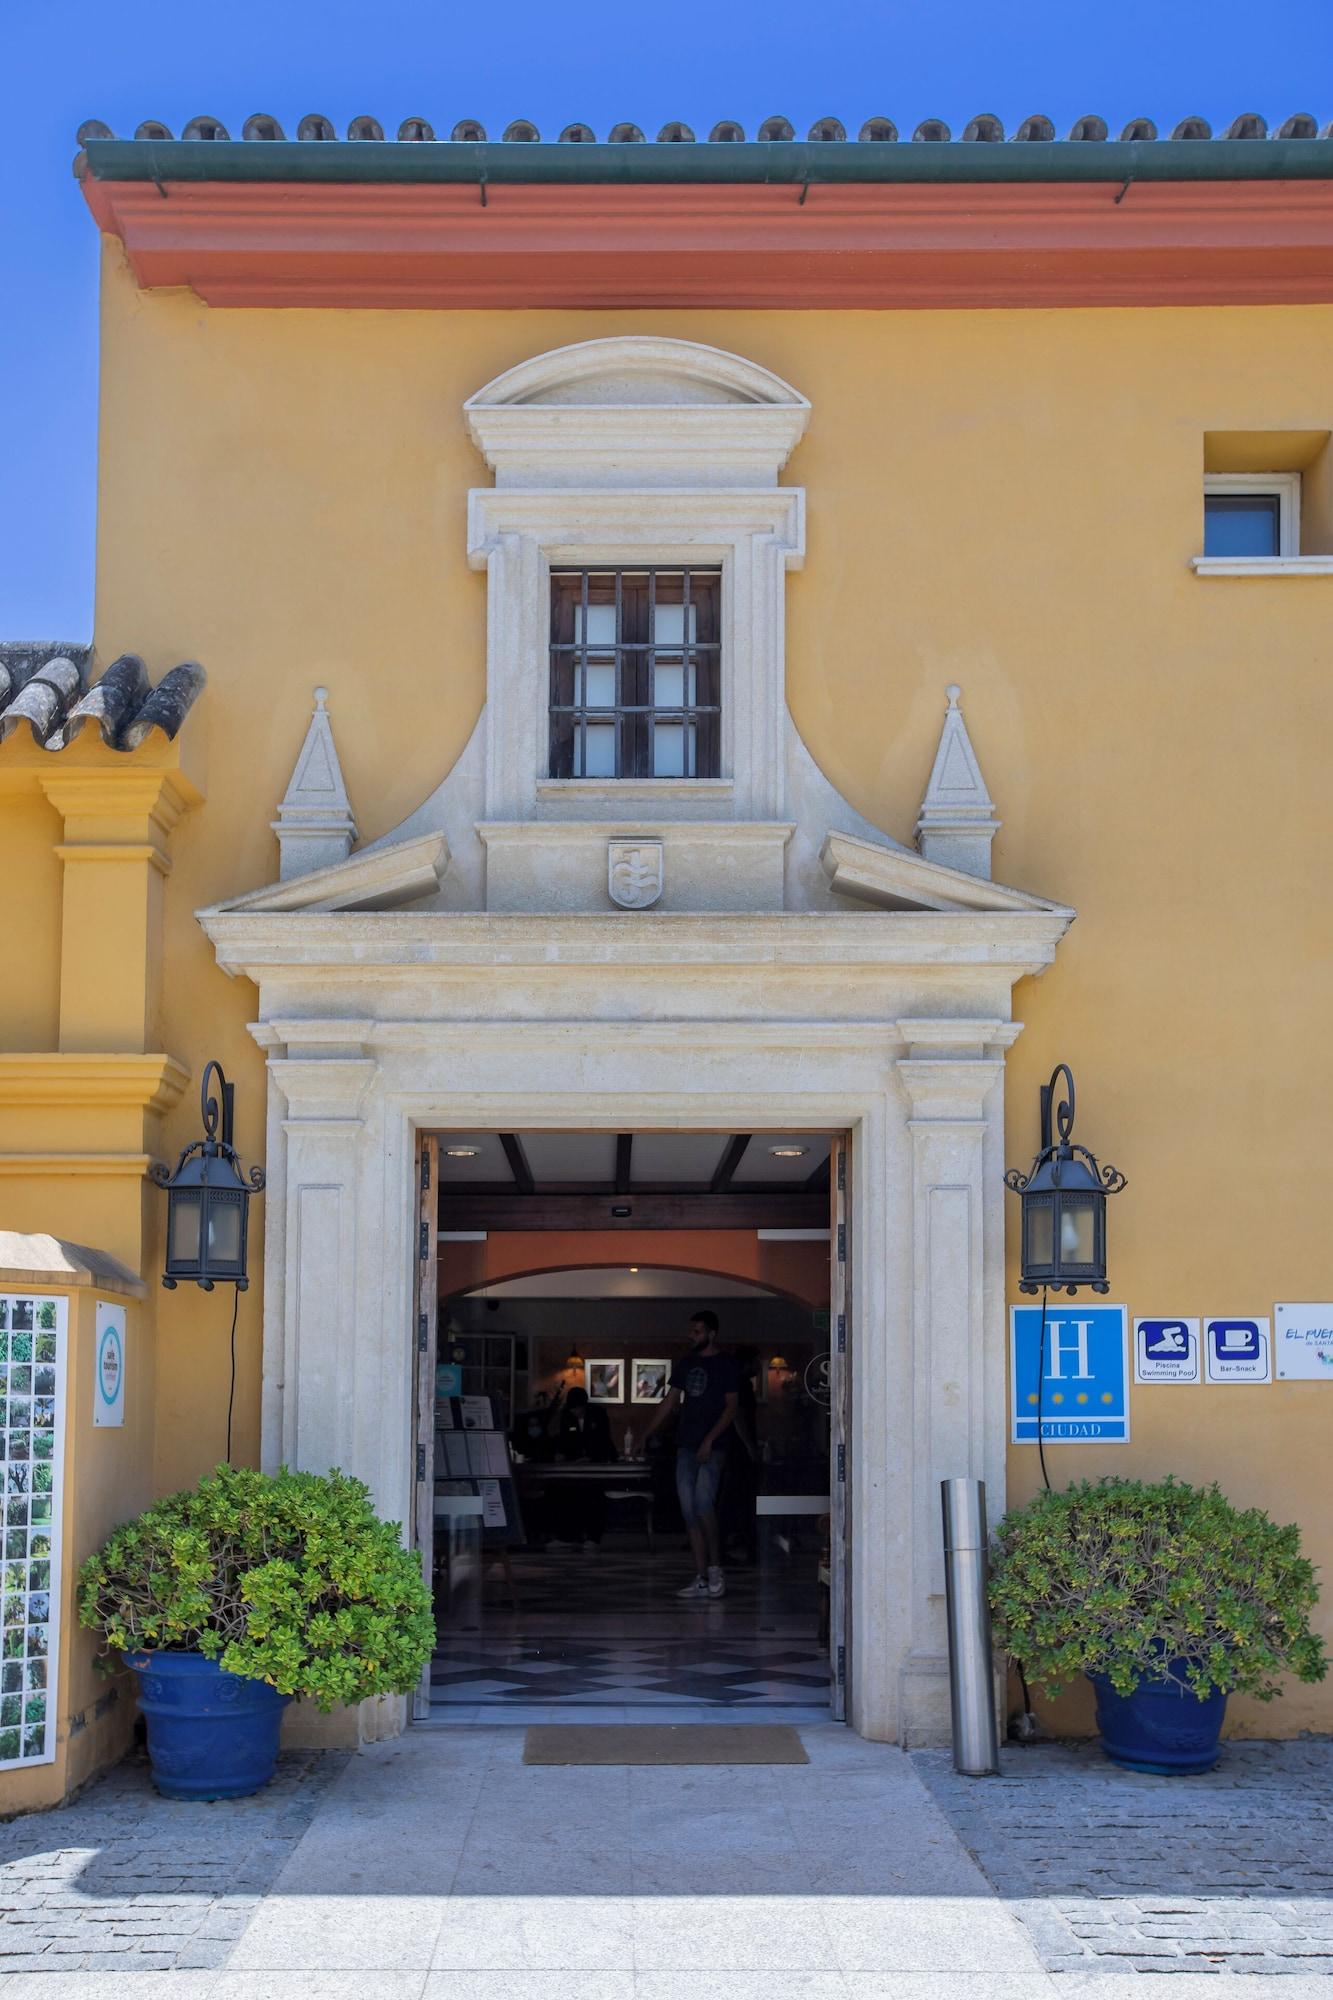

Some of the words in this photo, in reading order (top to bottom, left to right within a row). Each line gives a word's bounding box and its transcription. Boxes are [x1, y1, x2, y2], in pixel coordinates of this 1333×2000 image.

[1286, 1328, 1305, 1339] EL
[1044, 1320, 1095, 1380] H
[1142, 1369, 1177, 1377] Swimming
[1040, 1423, 1101, 1436] CIUDAD
